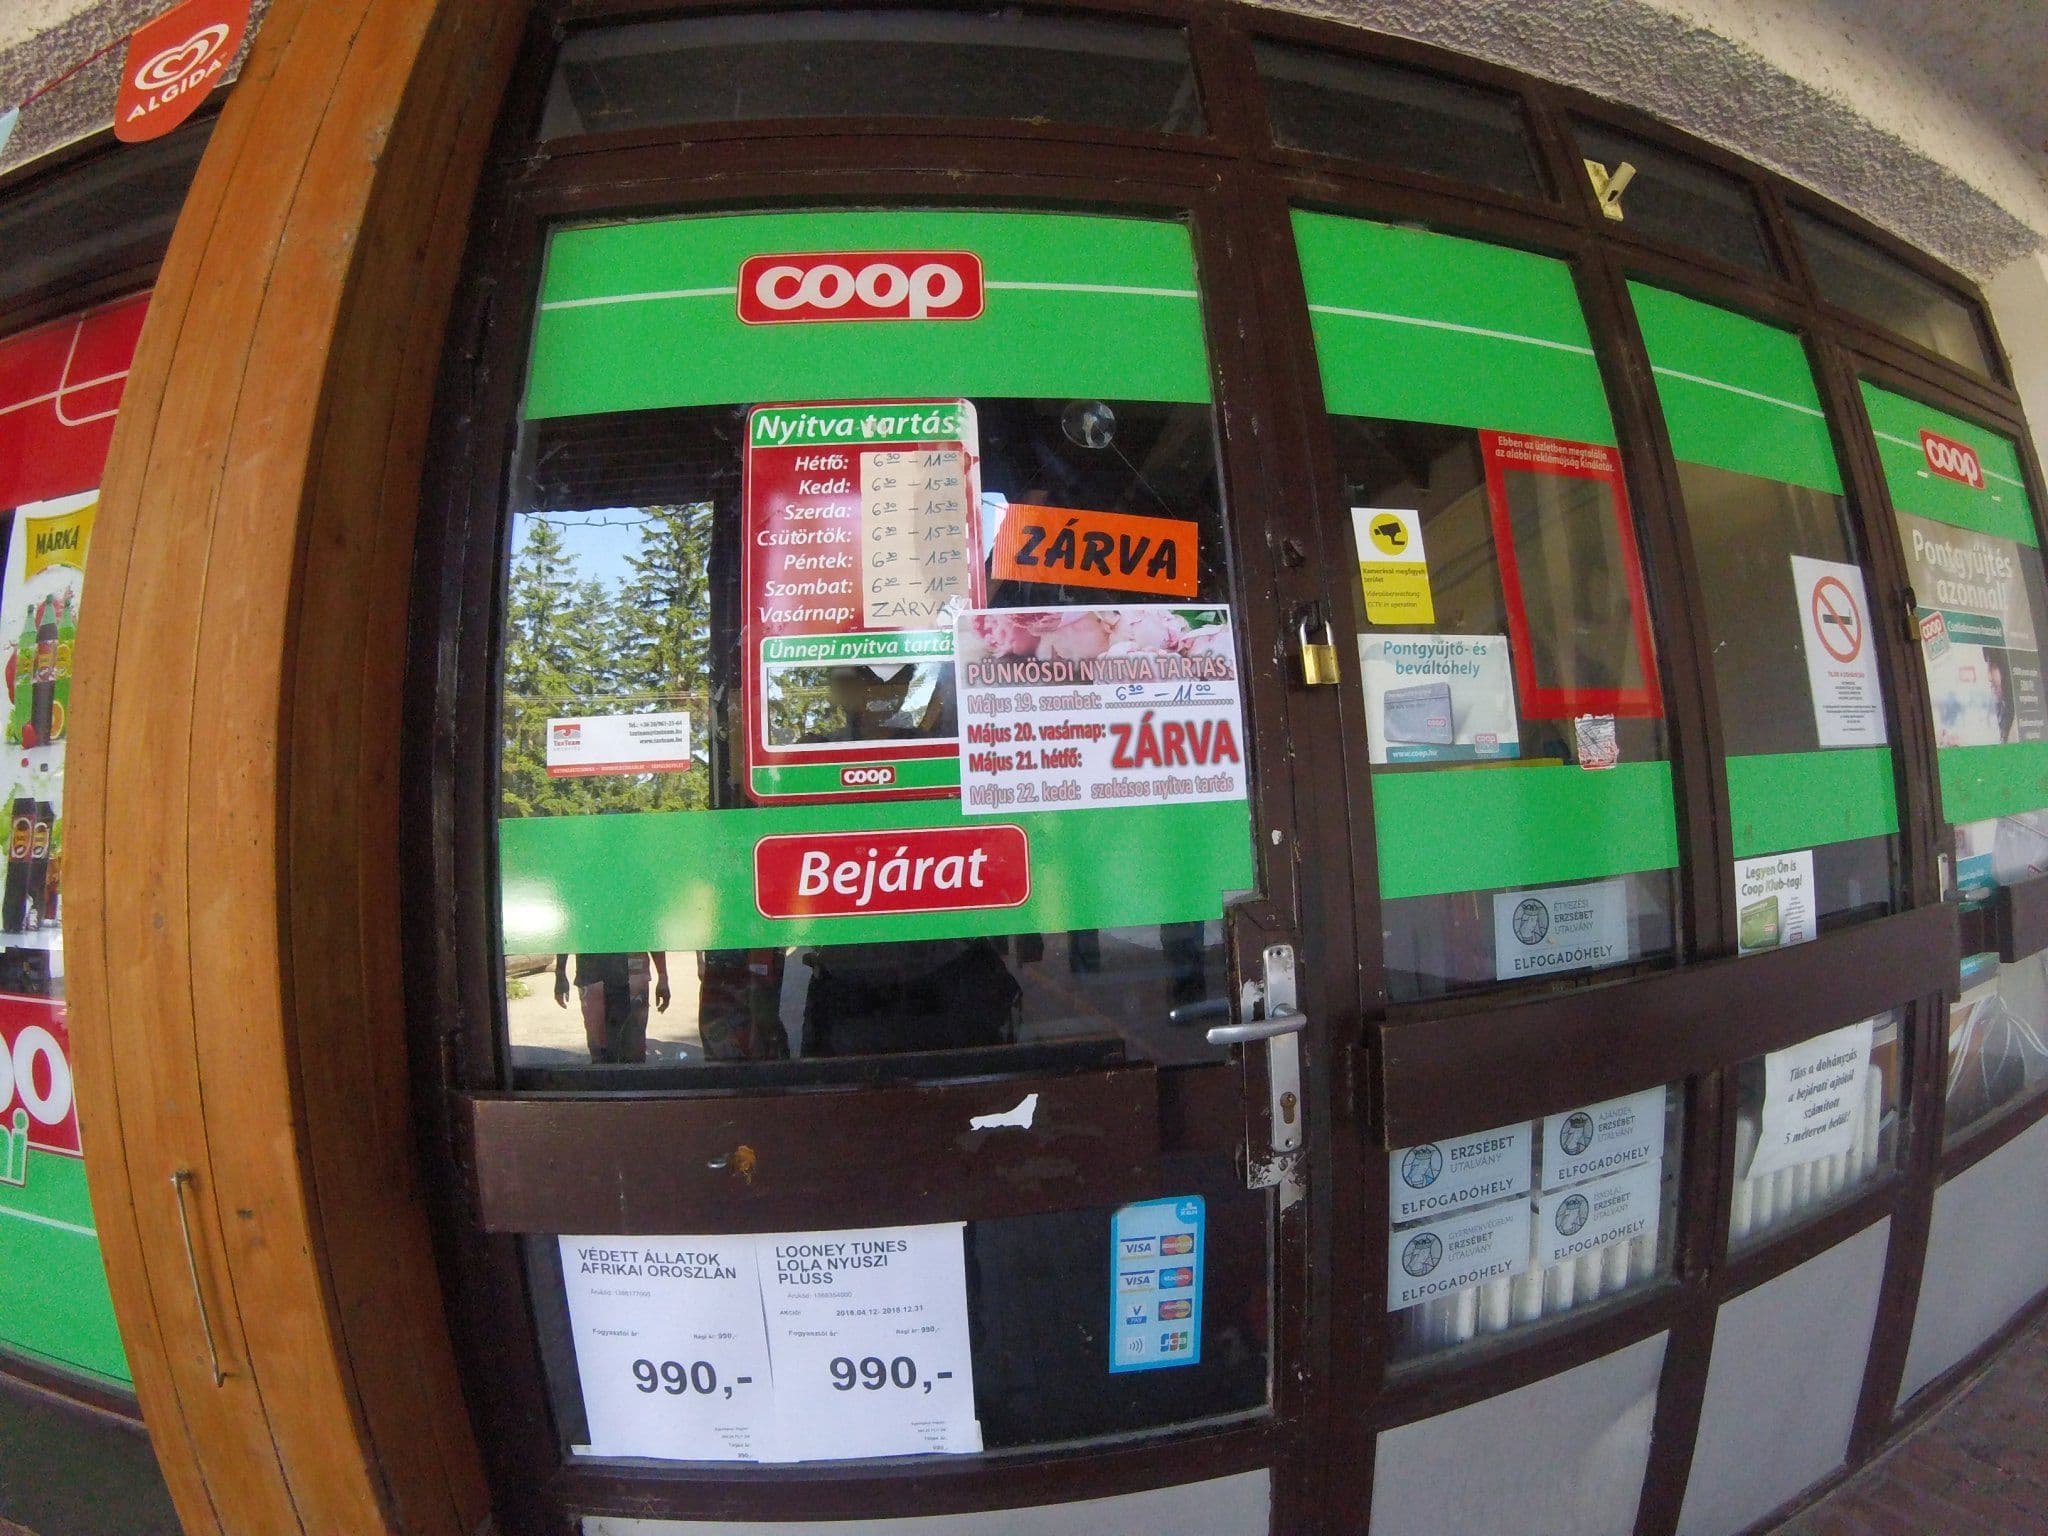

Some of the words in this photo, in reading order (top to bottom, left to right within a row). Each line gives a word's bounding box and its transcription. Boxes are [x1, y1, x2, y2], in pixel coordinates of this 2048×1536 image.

[127, 59, 222, 122] ALGIDA
[756, 263, 963, 319] coop
[757, 413, 854, 445] Nyitva
[1495, 449, 1505, 457] az
[1506, 449, 1531, 460] alábbi
[1498, 436, 1523, 447] Ebben
[1524, 441, 1534, 449] az
[1535, 442, 1568, 454] üzletben
[795, 454, 848, 472] Hétfő:
[1926, 438, 1978, 486] coop
[799, 479, 850, 494] Kedd:
[784, 504, 851, 520] Szerda:
[36, 525, 80, 557] MÁRKA
[757, 527, 851, 546] Csütörtök:
[1015, 518, 1177, 580] ZÁRVA
[784, 554, 852, 570] Péntek:
[765, 578, 853, 597] Szombat:
[760, 606, 854, 624] Vasárnap:
[770, 638, 837, 661] Ünnepi
[840, 640, 898, 658] nyitva
[1472, 642, 1487, 656] és
[967, 659, 1073, 686] PÜNKÖSDI
[1080, 658, 1152, 681] NYITVA
[1395, 661, 1480, 678] beváltóhely
[967, 694, 1011, 717] Május
[1015, 694, 1037, 712] 19.
[1039, 692, 1102, 710] szombat:
[967, 724, 1011, 747] Május
[1014, 724, 1037, 742] 20.
[1038, 720, 1106, 743] vasárnap:
[1110, 711, 1239, 769] ZÁRVA
[969, 752, 1012, 775] Május
[1015, 752, 1038, 770] 21.
[1041, 748, 1083, 769] hétfő:
[844, 769, 891, 784] coop
[970, 784, 1014, 808] Május
[1017, 784, 1039, 802] 22.
[1042, 781, 1081, 801] kedd:
[1091, 777, 1149, 799] szokásos
[1152, 778, 1192, 799] nyitva
[1195, 773, 1233, 792] tartás
[798, 846, 987, 906] Bejárat
[1746, 865, 1775, 880] Legyen
[1741, 883, 1764, 896] Coop
[1554, 910, 1594, 924] ERZSÉBET
[1555, 921, 1594, 935] UTALVÁNY
[1514, 945, 1613, 971] ELFOGADÓHELY
[1598, 1115, 1635, 1132] ERZSÉBET
[1598, 1127, 1634, 1143] UTALVÁNY
[1451, 1136, 1515, 1161] ERZSÉBET
[1450, 1153, 1503, 1173] UTALVÁNY
[1558, 1145, 1650, 1180] ELFOGADÓHELY
[1402, 1178, 1514, 1215] ELFOGADÓHELY
[1593, 1192, 1630, 1211] ERZSÉBET
[1593, 1204, 1629, 1221] UTALVÁNY
[776, 1244, 845, 1258] LOONEY
[850, 1240, 908, 1255] TUNES
[1126, 1243, 1152, 1253] VISA
[1449, 1232, 1494, 1251] ERZSÉBET
[1554, 1219, 1645, 1260] ELFOGADÓHELY
[578, 1247, 639, 1263] VÉDETT
[644, 1249, 720, 1266] ÁLLATOK
[1449, 1243, 1492, 1261] UTALVÁNY
[581, 1262, 643, 1276] AFRIKAI
[647, 1264, 737, 1279] OROSZLÁN
[777, 1259, 822, 1272] LOLA
[827, 1255, 888, 1270] NYUSZI
[778, 1269, 833, 1285] PLÜSS
[1126, 1276, 1150, 1286] VISA
[1402, 1260, 1513, 1301] ELFOGADÓHELY
[632, 1359, 752, 1400] 990,-
[829, 1356, 953, 1394] 990,-
